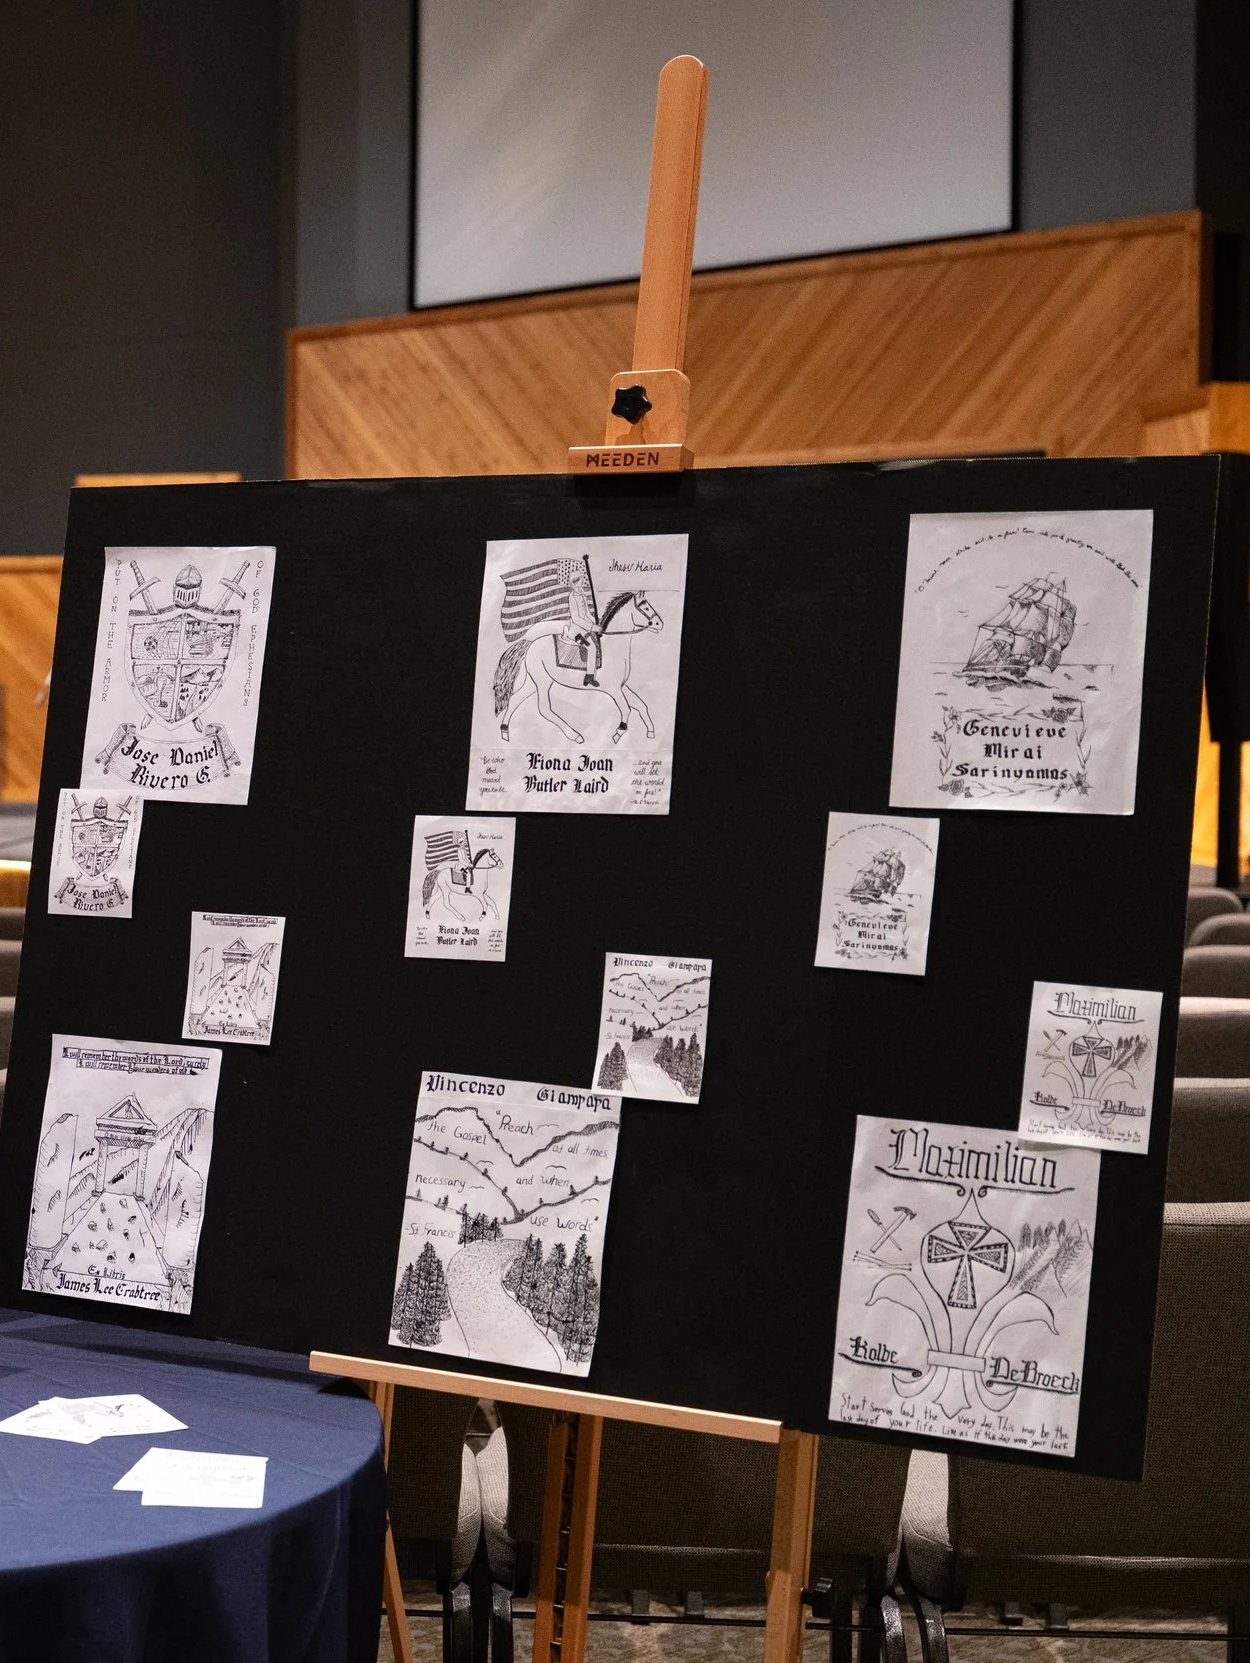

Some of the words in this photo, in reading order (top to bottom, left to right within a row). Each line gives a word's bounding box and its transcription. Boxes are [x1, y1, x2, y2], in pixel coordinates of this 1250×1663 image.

[586, 452, 659, 467] MEEDEN
[963, 719, 1067, 738] Genevieve
[121, 737, 159, 765] Jose
[170, 740, 219, 766] Daniel
[984, 743, 1041, 759] Mirai
[526, 753, 571, 771] Fiona
[578, 755, 613, 772] Joan
[130, 764, 188, 789] Rivero
[522, 776, 567, 793] Butler
[574, 777, 609, 794] Laird
[68, 884, 87, 898] Jose
[614, 957, 653, 967] Vincenzo
[1055, 992, 1136, 1020] Maximilian
[425, 1074, 505, 1096] Vincenzo
[536, 1086, 611, 1113] Giampapa
[454, 1126, 487, 1145] Gospel
[568, 1142, 580, 1154] all
[888, 1127, 1057, 1188] Maximilian
[415, 1174, 466, 1193] necessary
[516, 1175, 534, 1185] and
[542, 1174, 569, 1187] when
[530, 1216, 549, 1226] use
[56, 1273, 90, 1293] James
[93, 1278, 114, 1294] Lee
[116, 1282, 160, 1301] Crabtree
[849, 1336, 899, 1364] Kolbe
[840, 1392, 867, 1411] Start
[924, 1406, 938, 1420] the
[997, 1416, 1014, 1432] This
[1041, 1423, 1049, 1438] be
[1055, 1425, 1069, 1440] the
[890, 1418, 911, 1428] your
